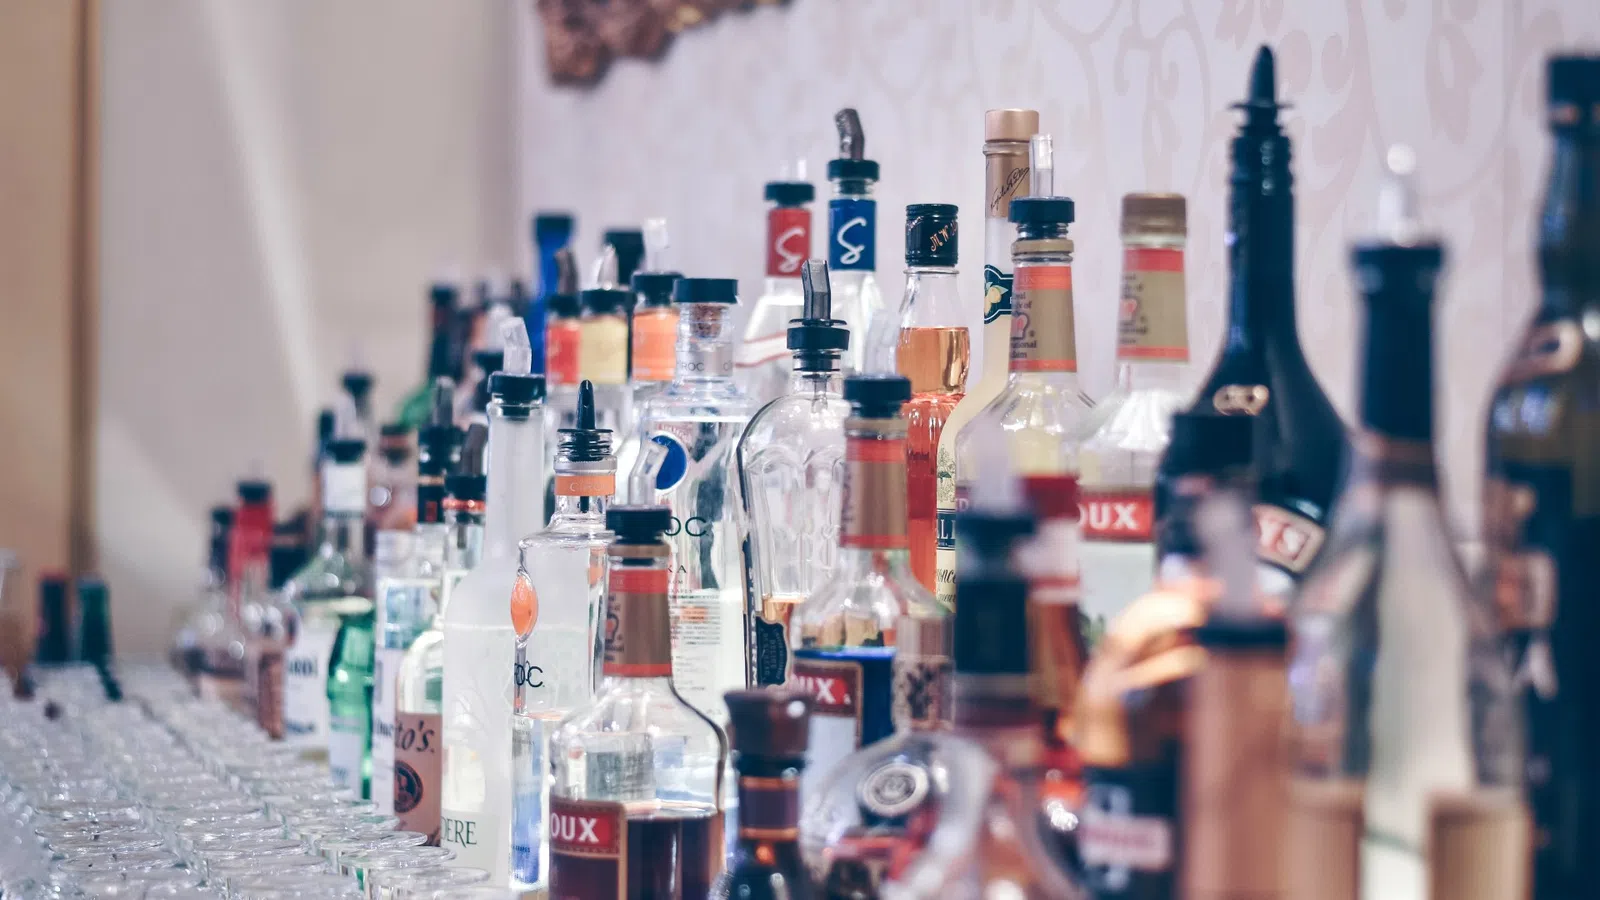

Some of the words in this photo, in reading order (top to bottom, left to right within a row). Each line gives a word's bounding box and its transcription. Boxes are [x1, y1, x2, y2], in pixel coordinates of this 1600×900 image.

[775, 226, 806, 273] S
[836, 217, 868, 265] S
[551, 812, 599, 843] OUX
